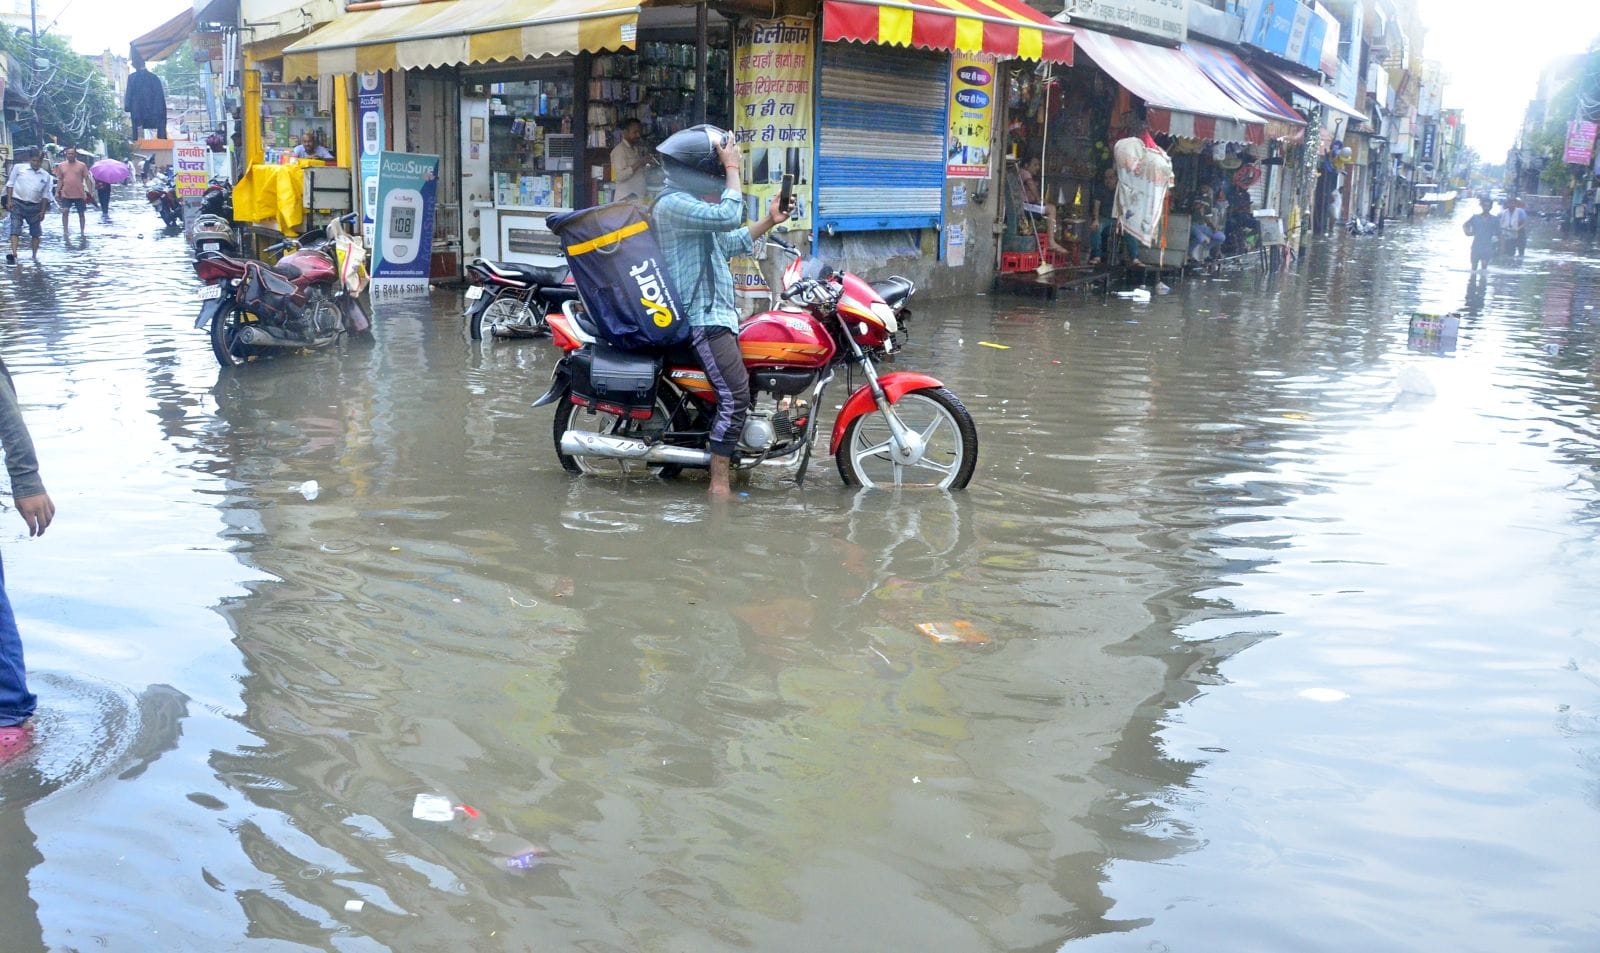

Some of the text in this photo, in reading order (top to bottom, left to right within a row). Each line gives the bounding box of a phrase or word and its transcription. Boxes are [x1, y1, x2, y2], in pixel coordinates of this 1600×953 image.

[760, 98, 775, 116] ही
[779, 103, 795, 116] टच
[761, 124, 775, 142] ही
[778, 124, 807, 142] फोल्डर
[383, 159, 435, 174] AccuSure
[395, 217, 411, 233] 108
[629, 260, 673, 328] ekart
